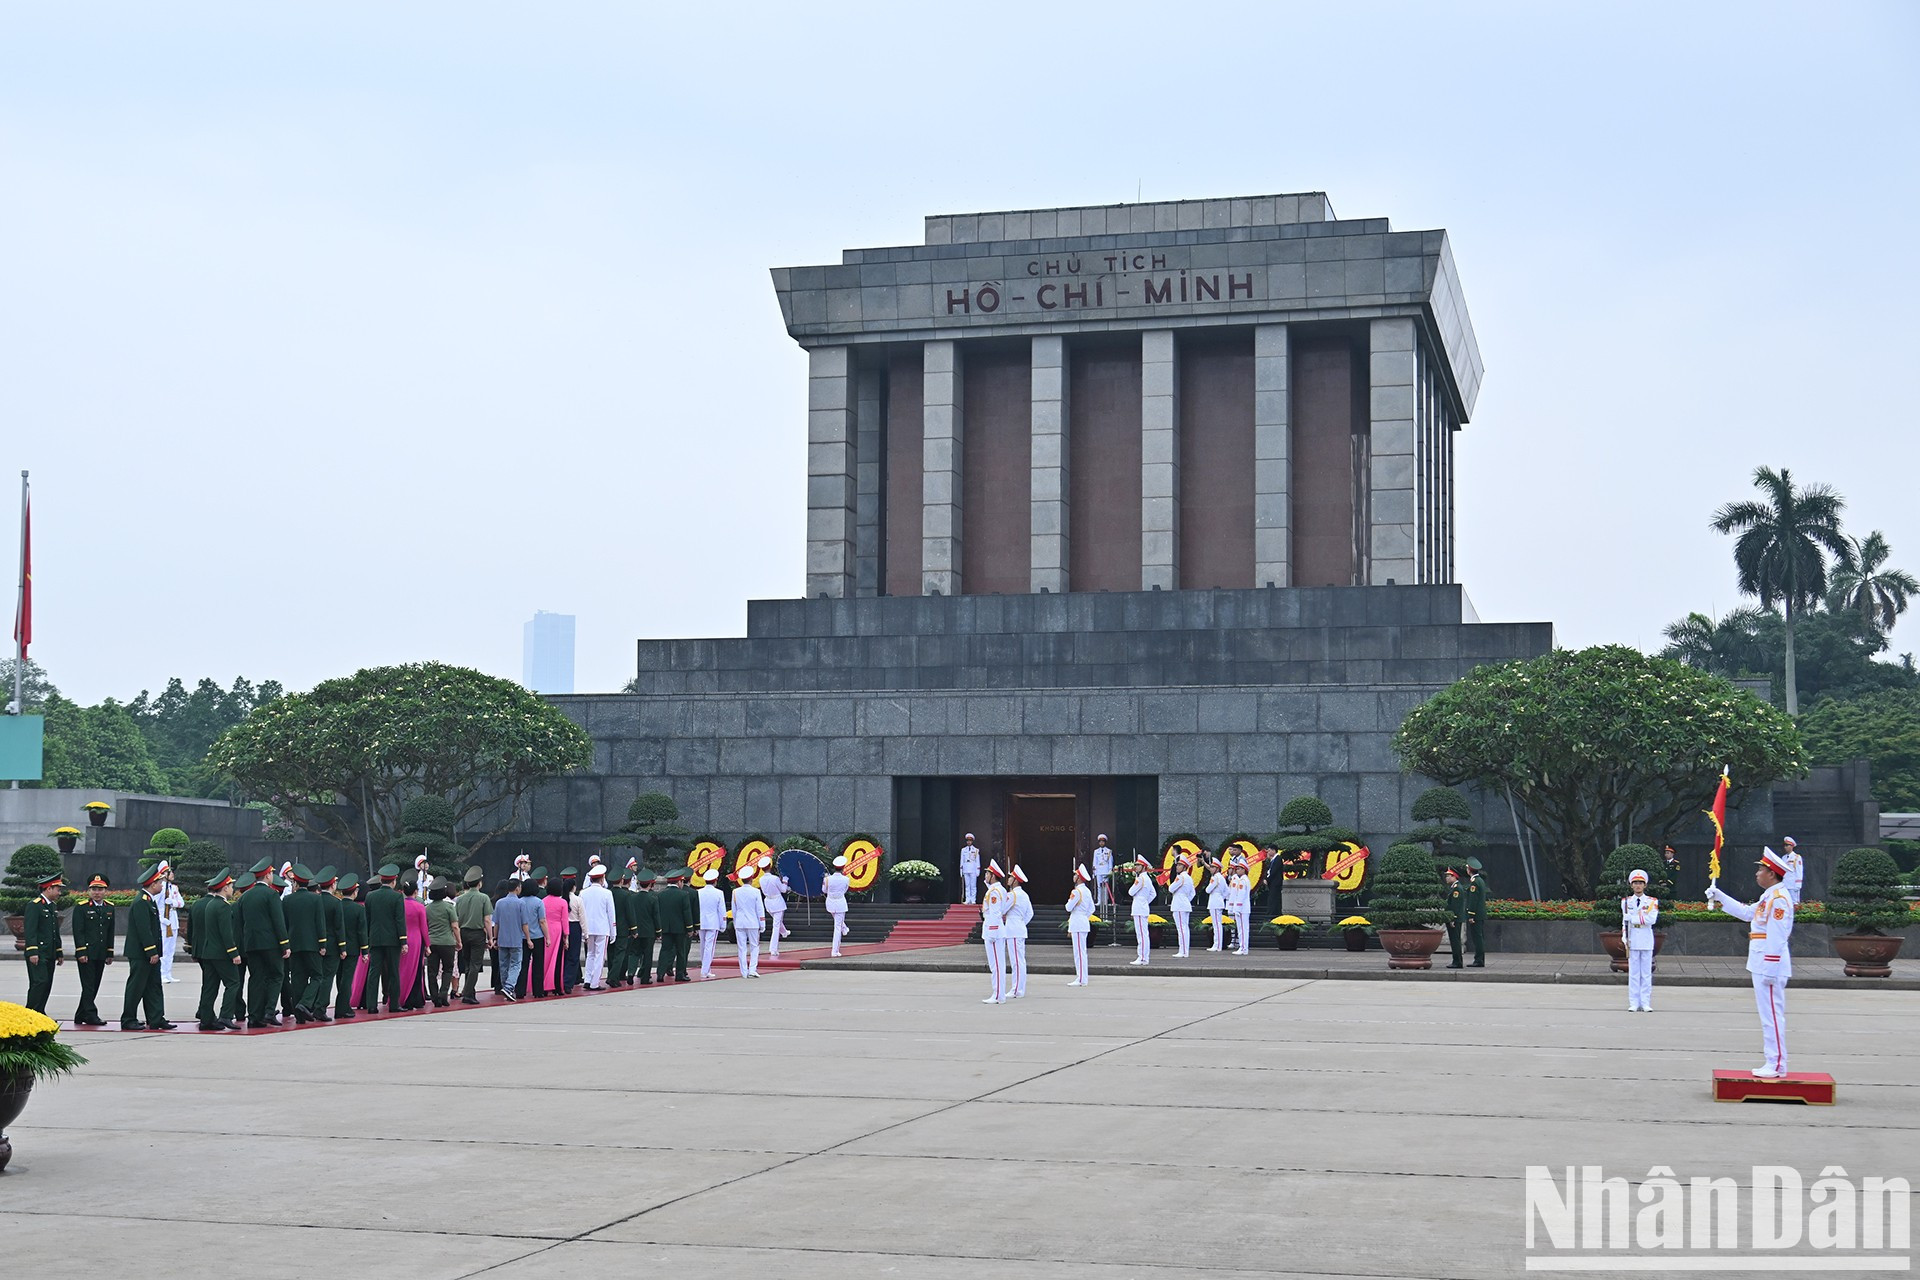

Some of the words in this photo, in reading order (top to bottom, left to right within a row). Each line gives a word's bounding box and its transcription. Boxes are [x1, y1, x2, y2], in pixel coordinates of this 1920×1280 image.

[1027, 252, 1081, 276] CHỦ
[946, 281, 1001, 315] HỒ
[1036, 274, 1106, 310] CHÍ
